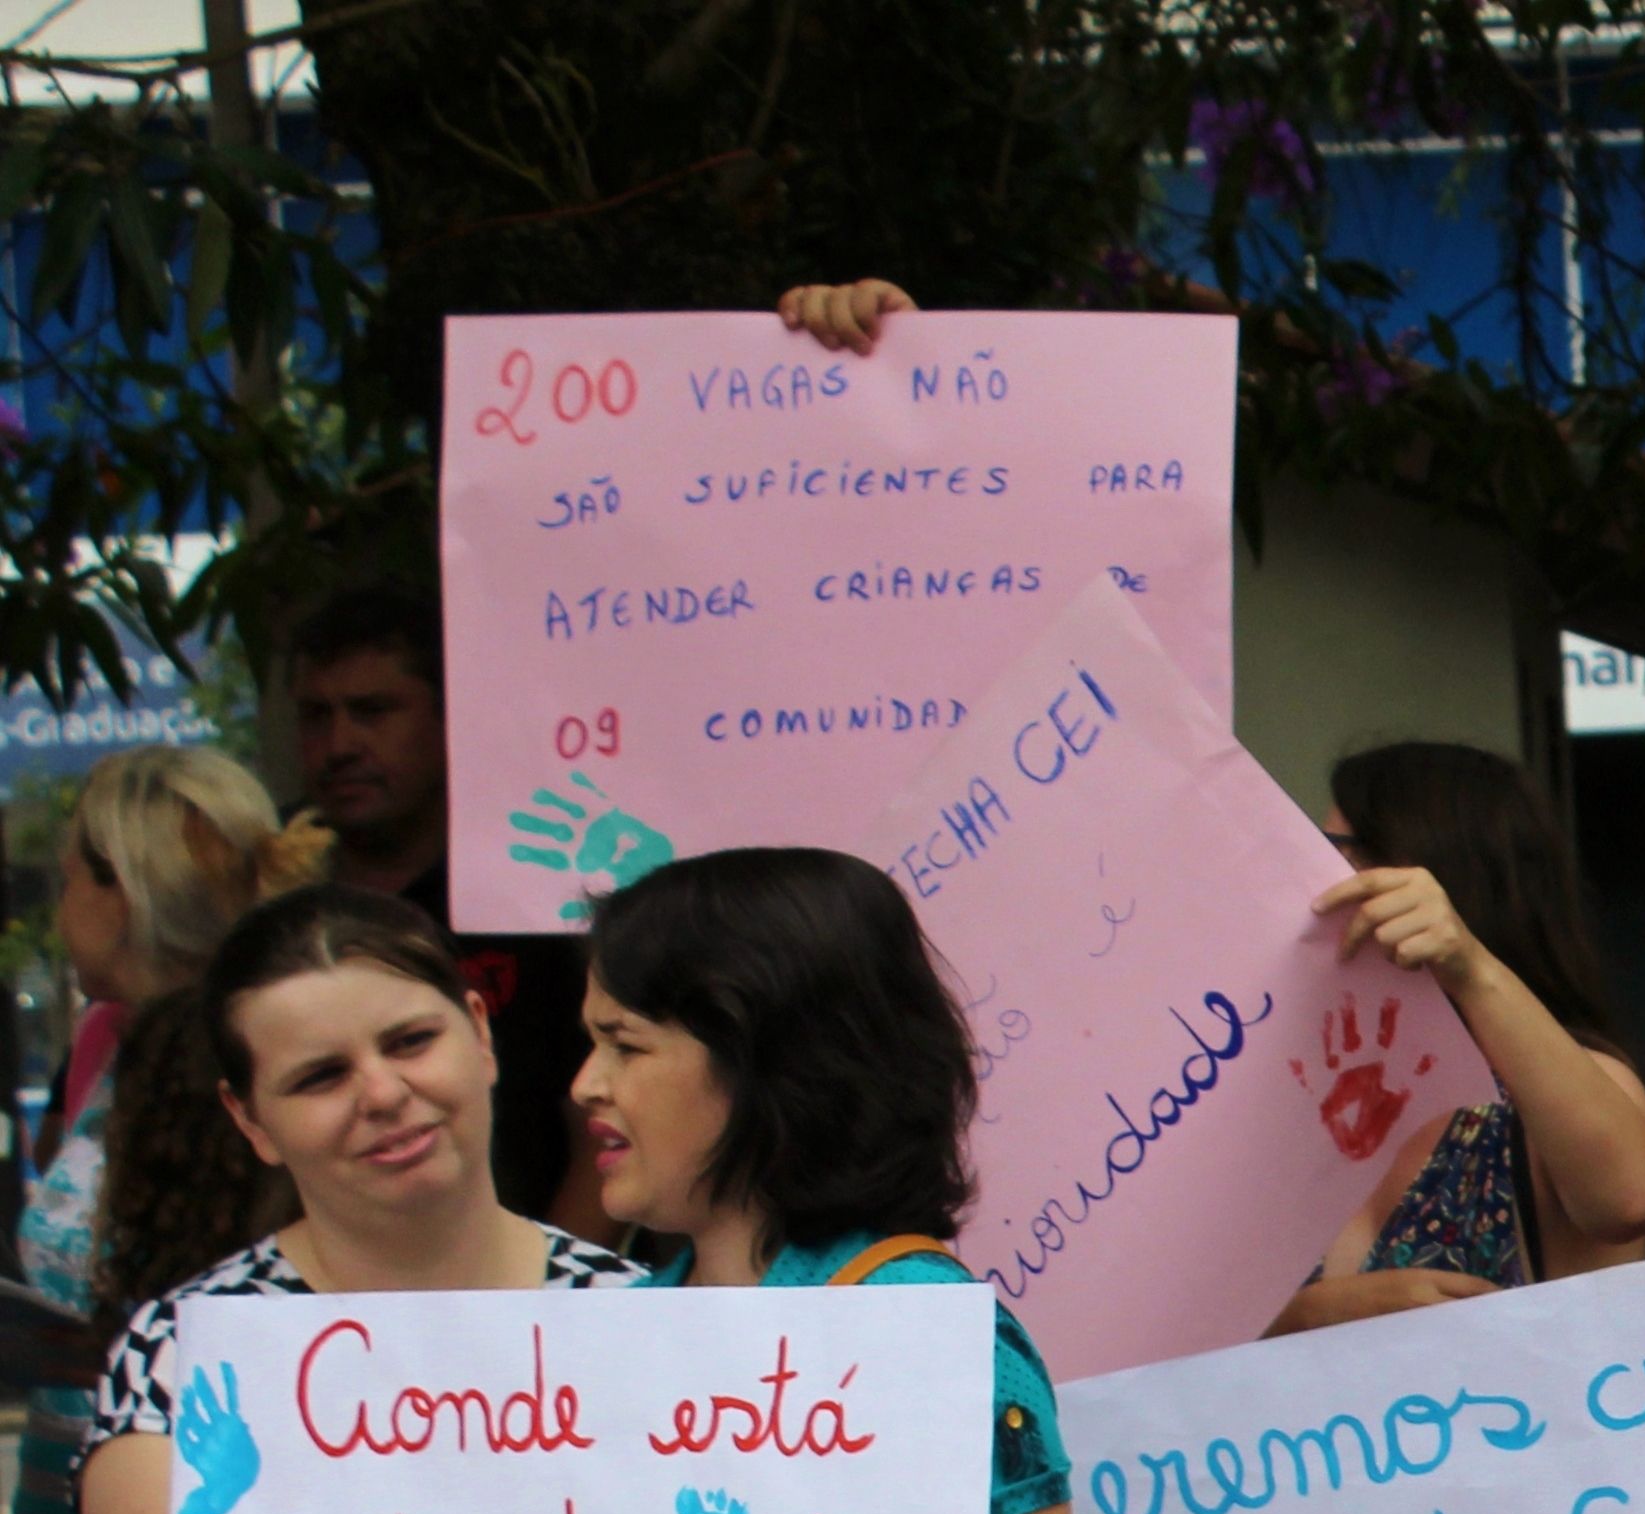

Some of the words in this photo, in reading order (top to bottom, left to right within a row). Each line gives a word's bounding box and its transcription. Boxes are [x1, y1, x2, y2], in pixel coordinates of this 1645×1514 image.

[476, 350, 637, 445] 200
[691, 366, 848, 410] VAGAS
[912, 352, 1007, 400] NÃO
[540, 477, 620, 529] SÃO
[1089, 461, 1183, 491] PARA
[545, 581, 754, 639] ATENDER
[555, 708, 620, 760] 09
[886, 779, 1011, 898] ECHA
[1014, 671, 1117, 784] CEI
[982, 990, 1273, 1300] rioridade
[295, 1318, 596, 1459] Aonde
[648, 1336, 876, 1458] está
